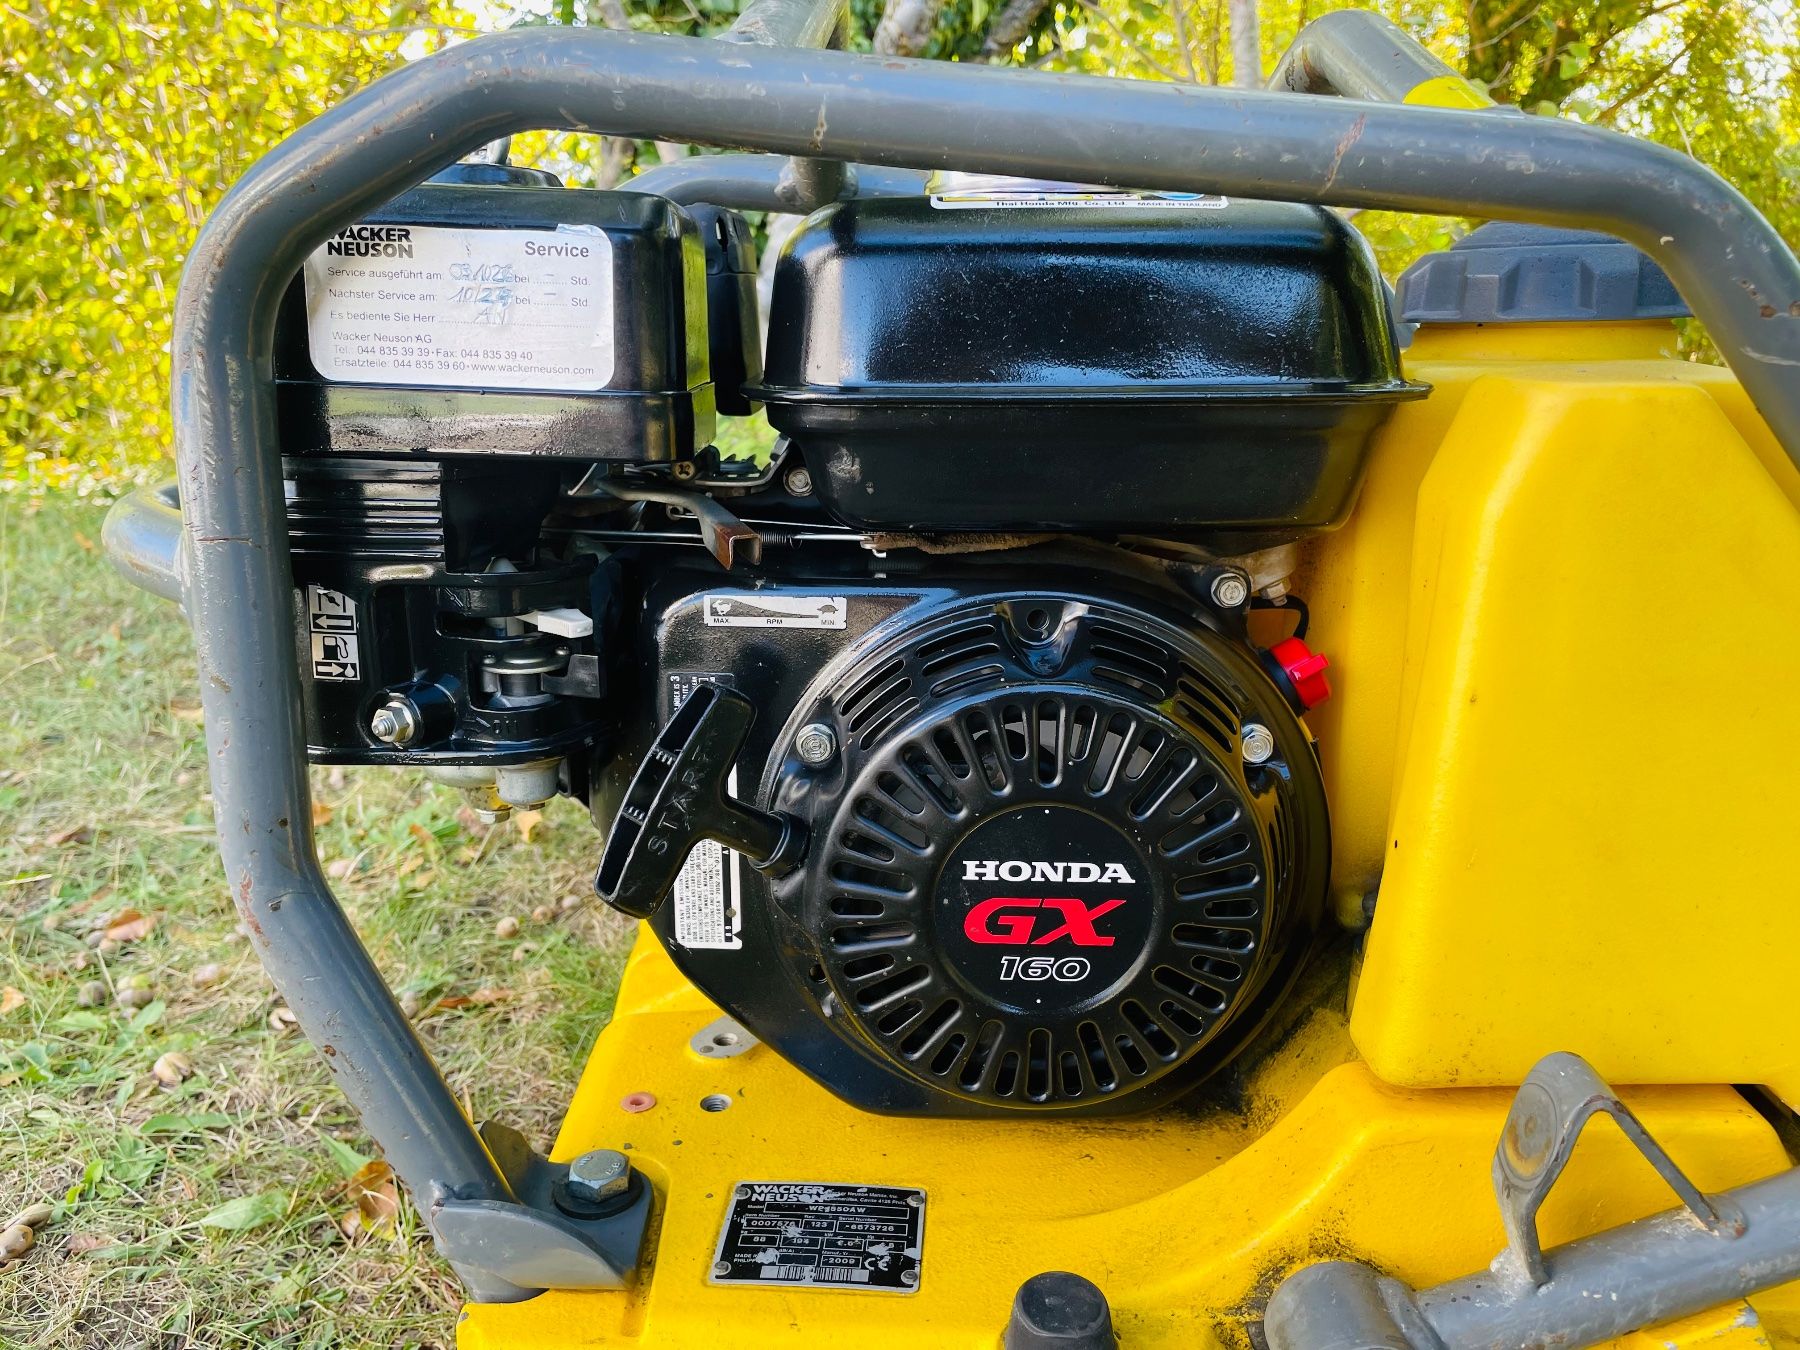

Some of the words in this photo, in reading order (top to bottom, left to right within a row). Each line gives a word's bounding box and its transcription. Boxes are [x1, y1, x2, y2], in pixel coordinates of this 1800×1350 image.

[327, 241, 414, 259] NEUSON
[525, 241, 590, 258] Service
[327, 267, 366, 277] Service
[368, 270, 423, 280] ausgeführt
[514, 274, 530, 283] bei
[570, 276, 591, 286] Std.
[378, 290, 416, 300] Service
[515, 295, 531, 305] bei
[347, 312, 391, 322] bediente
[394, 312, 410, 322] Sie
[332, 331, 370, 342] Wacker
[374, 333, 413, 343] Neuson
[415, 334, 432, 344] AG
[357, 345, 376, 355] 044
[380, 346, 398, 356] 835
[401, 347, 414, 357] 39
[461, 349, 479, 358] 044
[483, 349, 502, 359] 835
[505, 351, 517, 360] 39
[520, 352, 533, 360] 40
[394, 359, 411, 369] 044
[416, 360, 433, 370] 835
[438, 360, 450, 370] 39
[647, 744, 709, 856] START
[962, 860, 1136, 883] HONDA
[964, 898, 1127, 946] GX
[1000, 956, 1091, 982] 160
[753, 1185, 825, 1194] WACKER
